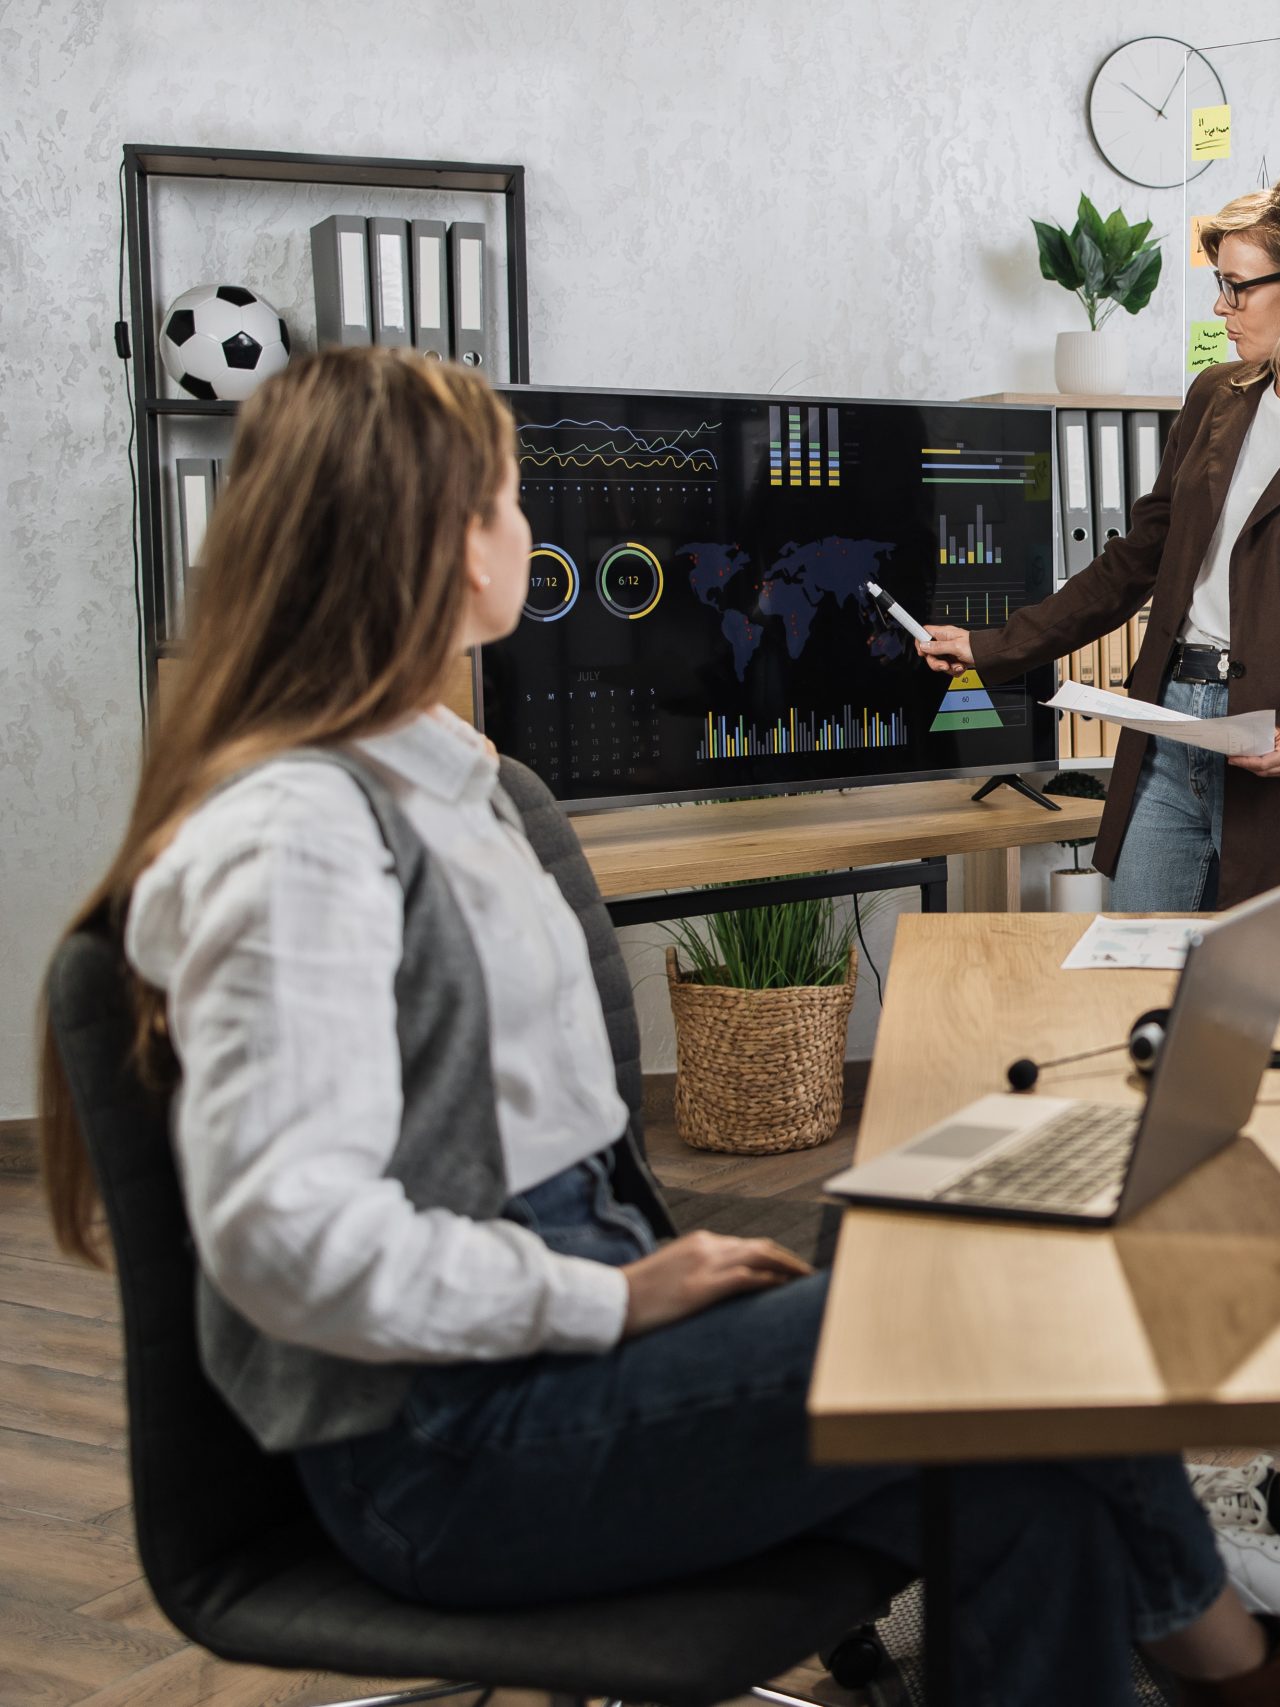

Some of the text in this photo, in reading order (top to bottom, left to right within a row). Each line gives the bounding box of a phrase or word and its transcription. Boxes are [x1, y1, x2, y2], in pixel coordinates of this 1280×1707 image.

[530, 576, 558, 588] 17/12
[618, 575, 640, 587] 6/12
[577, 671, 601, 682] JULY
[962, 695, 969, 703] 60
